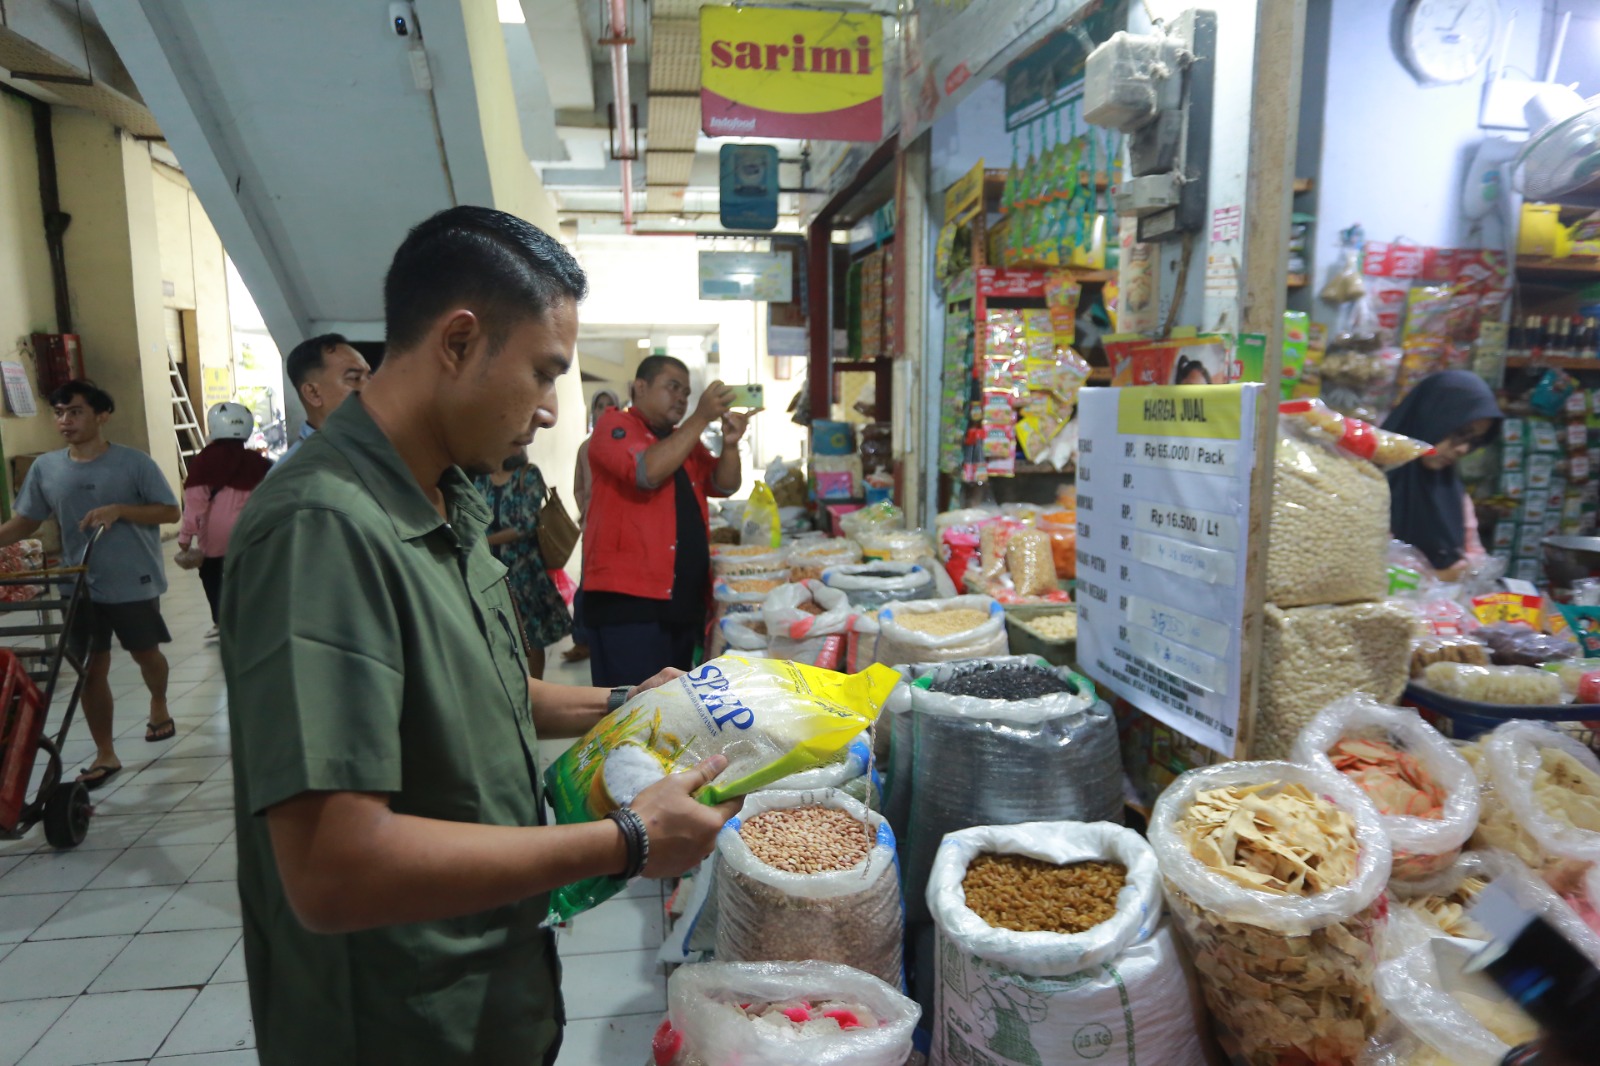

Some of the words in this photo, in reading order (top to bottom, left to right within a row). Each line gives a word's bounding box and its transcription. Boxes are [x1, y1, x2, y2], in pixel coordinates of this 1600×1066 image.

[710, 34, 872, 75] sarimi
[709, 116, 757, 130] Indofood
[1143, 398, 1178, 423] HARGA
[1180, 398, 1207, 423] JUAL
[1197, 447, 1225, 465] Pack
[1151, 508, 1164, 527] Rp
[1166, 512, 1198, 532] 16.500
[1207, 519, 1219, 537] Lt
[687, 665, 755, 732] SPHP
